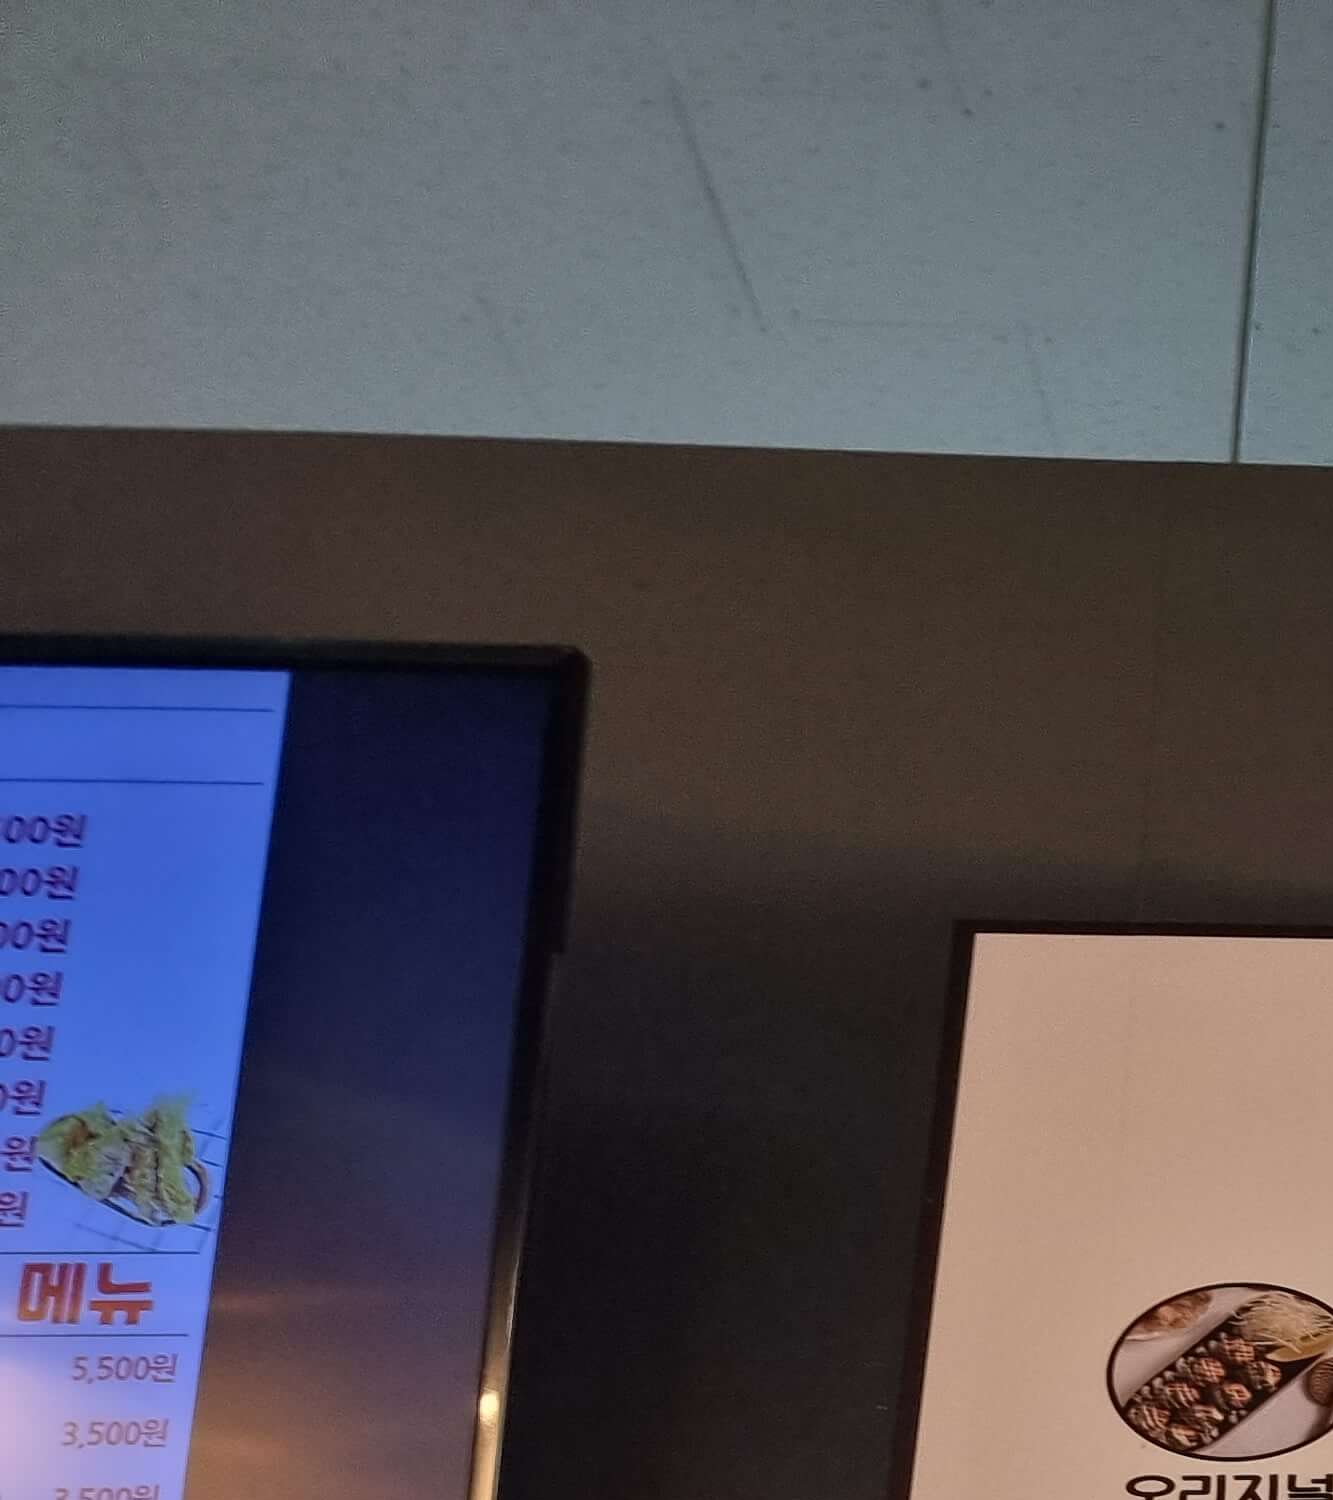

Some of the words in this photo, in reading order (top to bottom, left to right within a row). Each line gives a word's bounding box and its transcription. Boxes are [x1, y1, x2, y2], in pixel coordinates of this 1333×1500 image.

[19, 1262, 153, 1325] 메뉴
[71, 1353, 178, 1384] 5,500원
[62, 1418, 169, 1449] 3,500원
